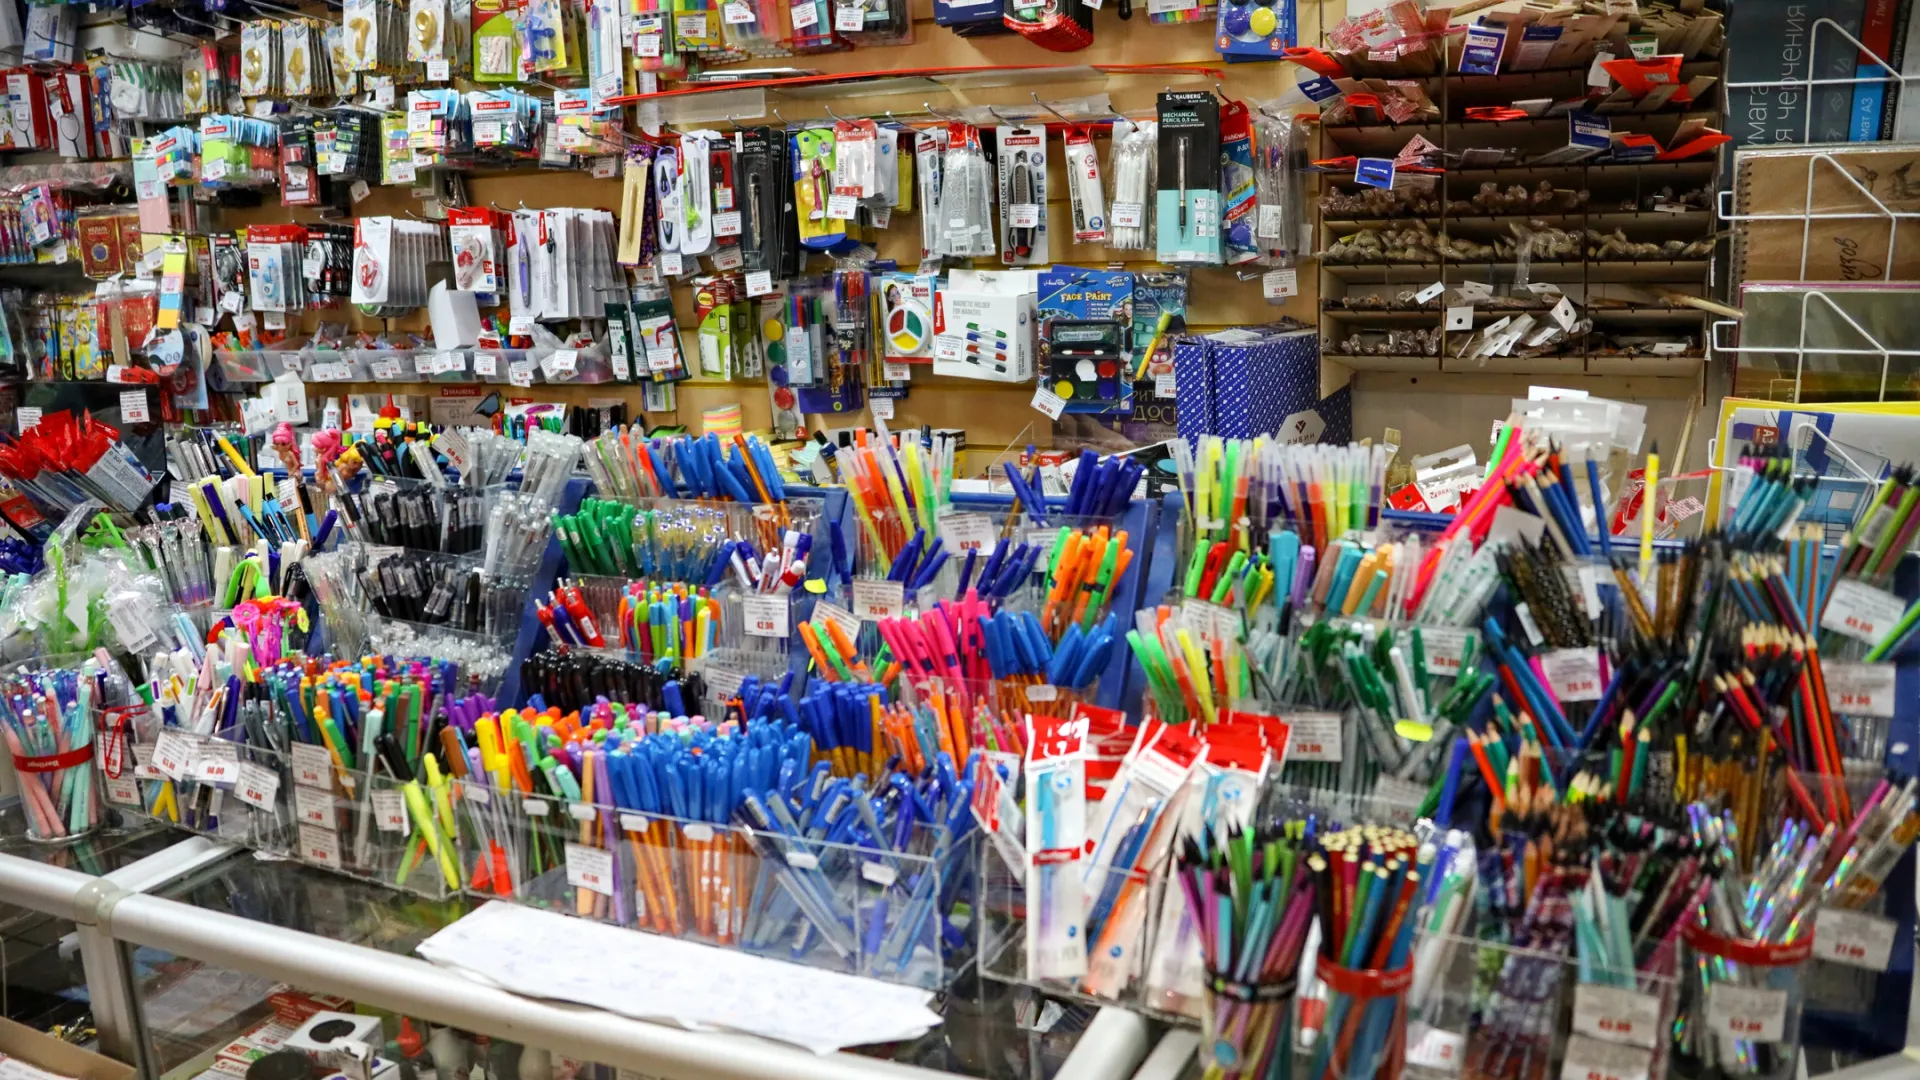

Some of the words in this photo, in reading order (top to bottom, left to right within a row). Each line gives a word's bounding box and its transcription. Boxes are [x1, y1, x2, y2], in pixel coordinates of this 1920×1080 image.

[1777, 5, 1807, 120] черчения
[1574, 120, 1605, 129] Berlingo
[1363, 166, 1389, 175] Berlingo
[1060, 294, 1083, 302] FACE
[831, 386, 840, 394] 12
[1287, 432, 1315, 446] РУБИН
